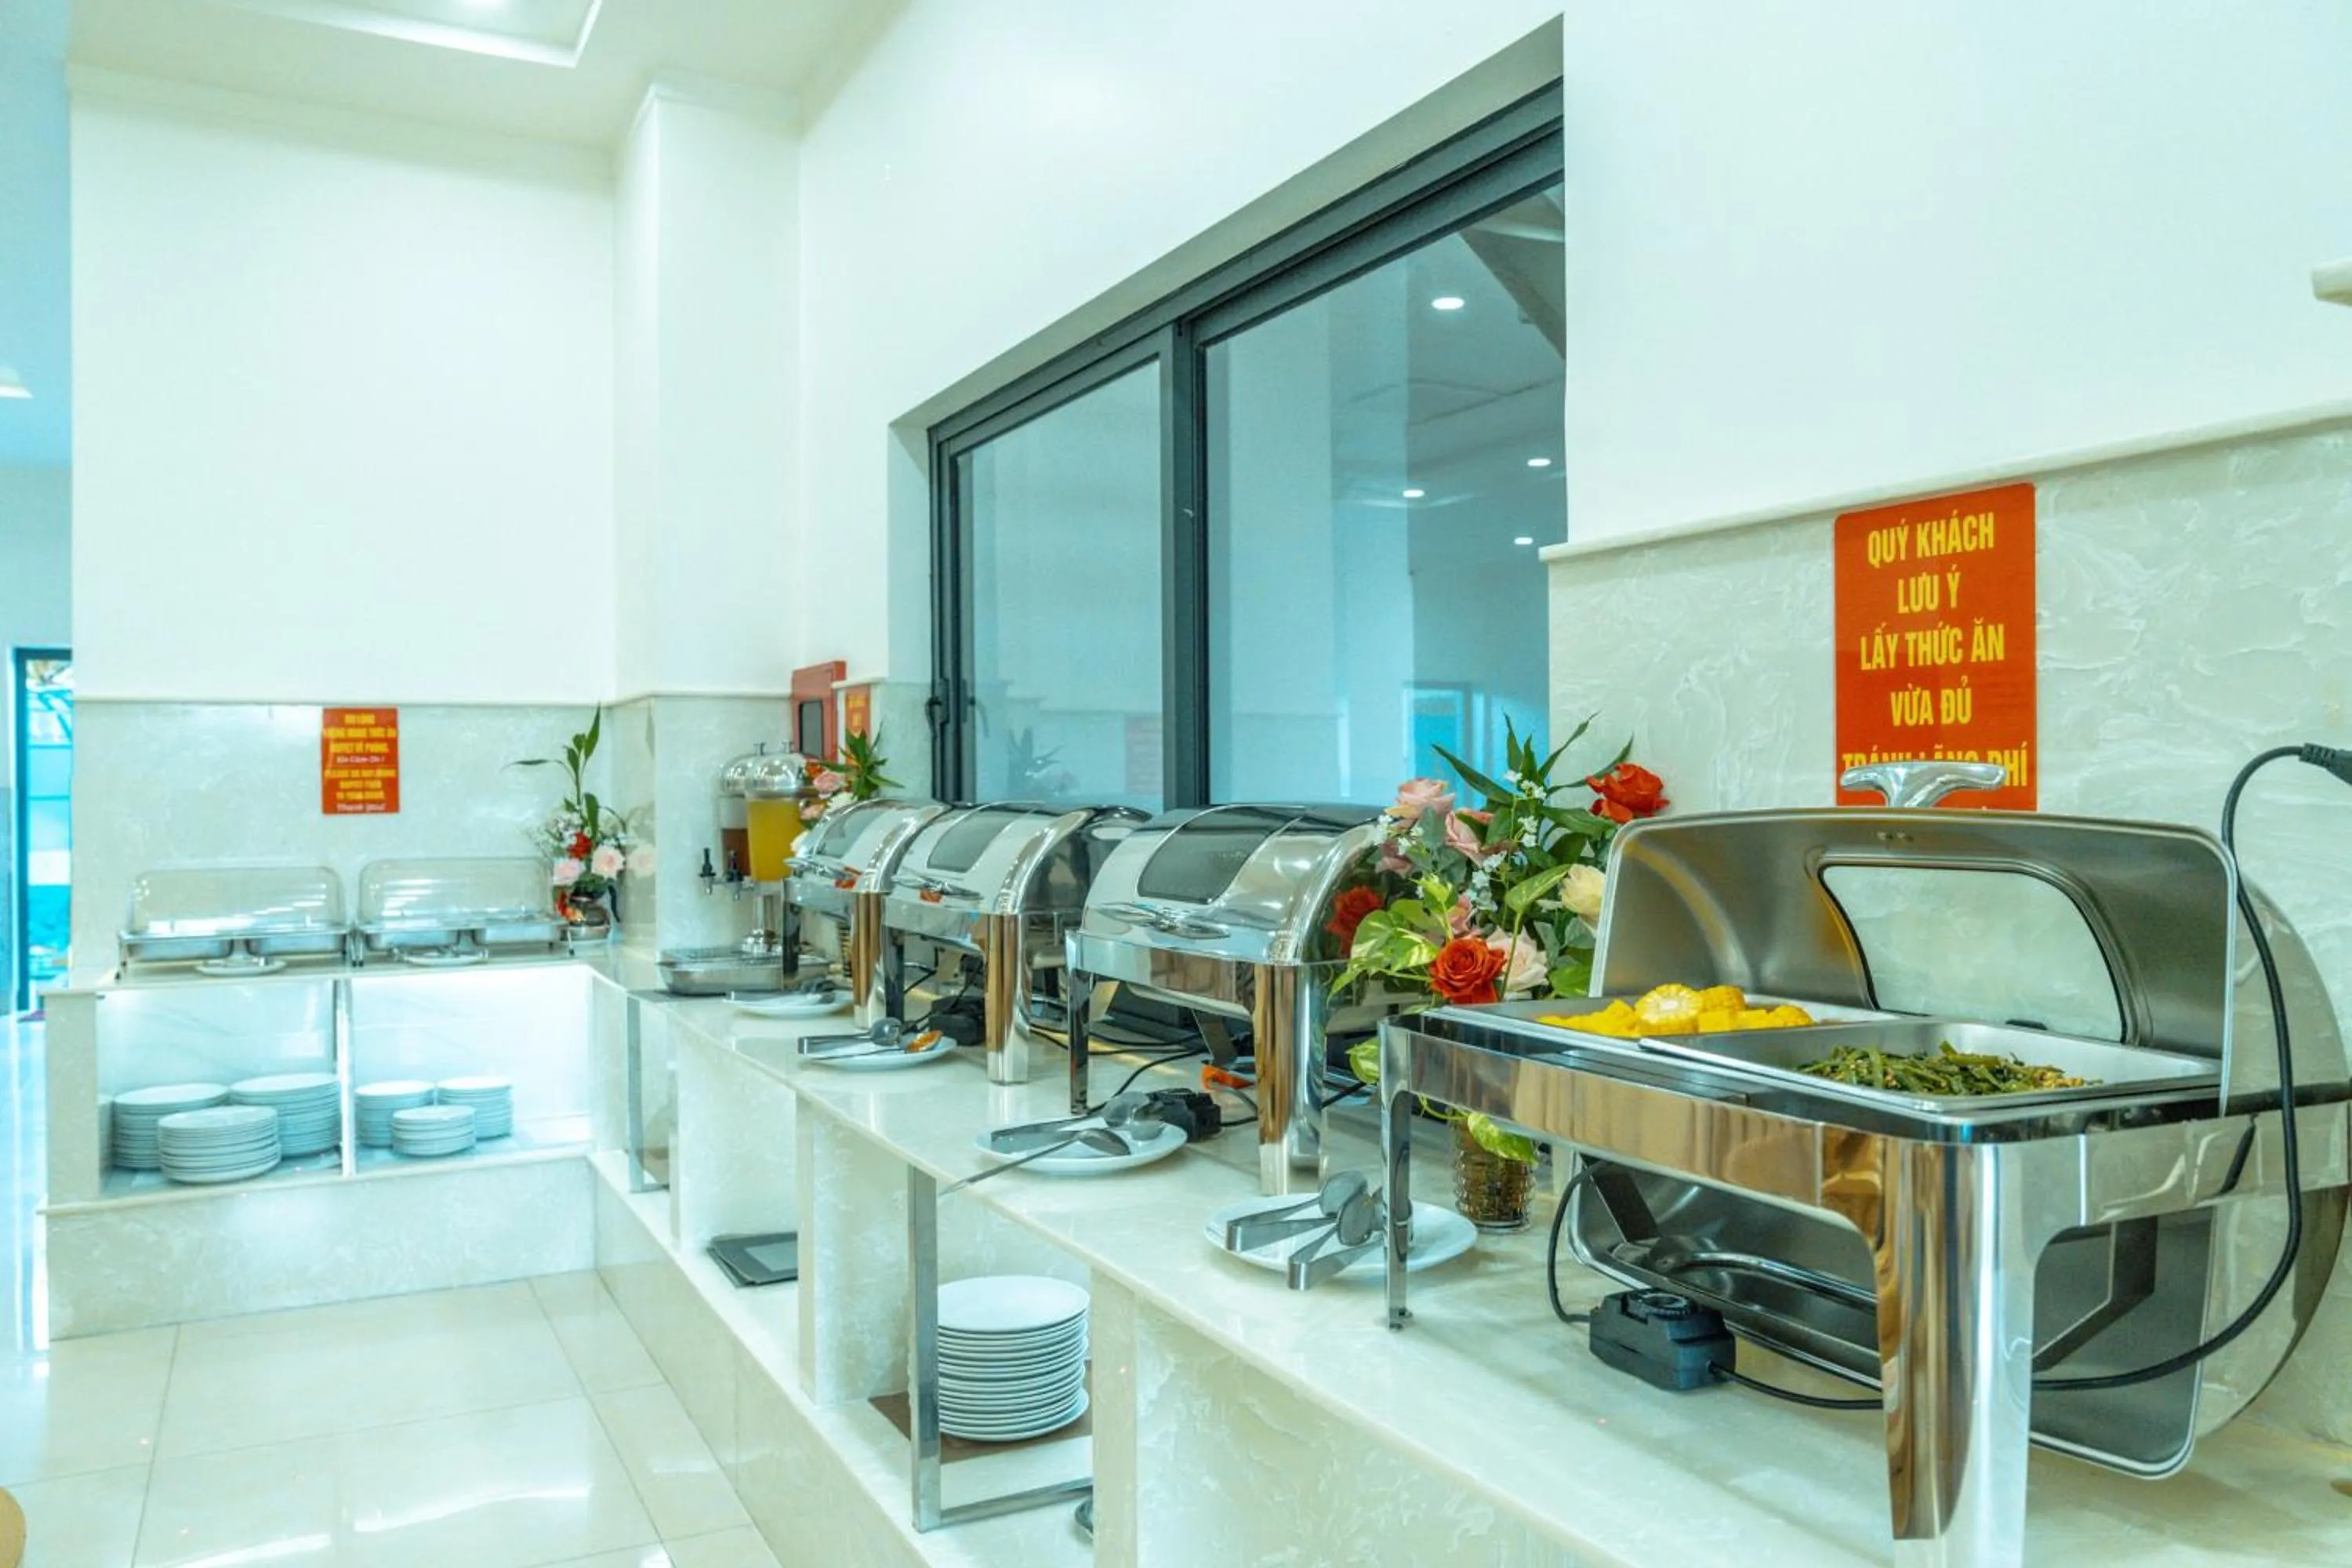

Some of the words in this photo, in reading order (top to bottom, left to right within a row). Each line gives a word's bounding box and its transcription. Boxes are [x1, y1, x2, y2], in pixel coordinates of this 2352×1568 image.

[1868, 517, 1909, 569] QUÝ
[1917, 509, 1994, 558] KHÁCH
[1898, 572, 1940, 614] LƯU
[1946, 564, 1961, 609] Ý
[1860, 621, 1899, 670] LẤY
[1904, 620, 1963, 667] THỨC
[1970, 616, 2005, 662] ĂN
[1890, 683, 1934, 727] VỪA
[1940, 675, 1972, 724] ĐỦ
